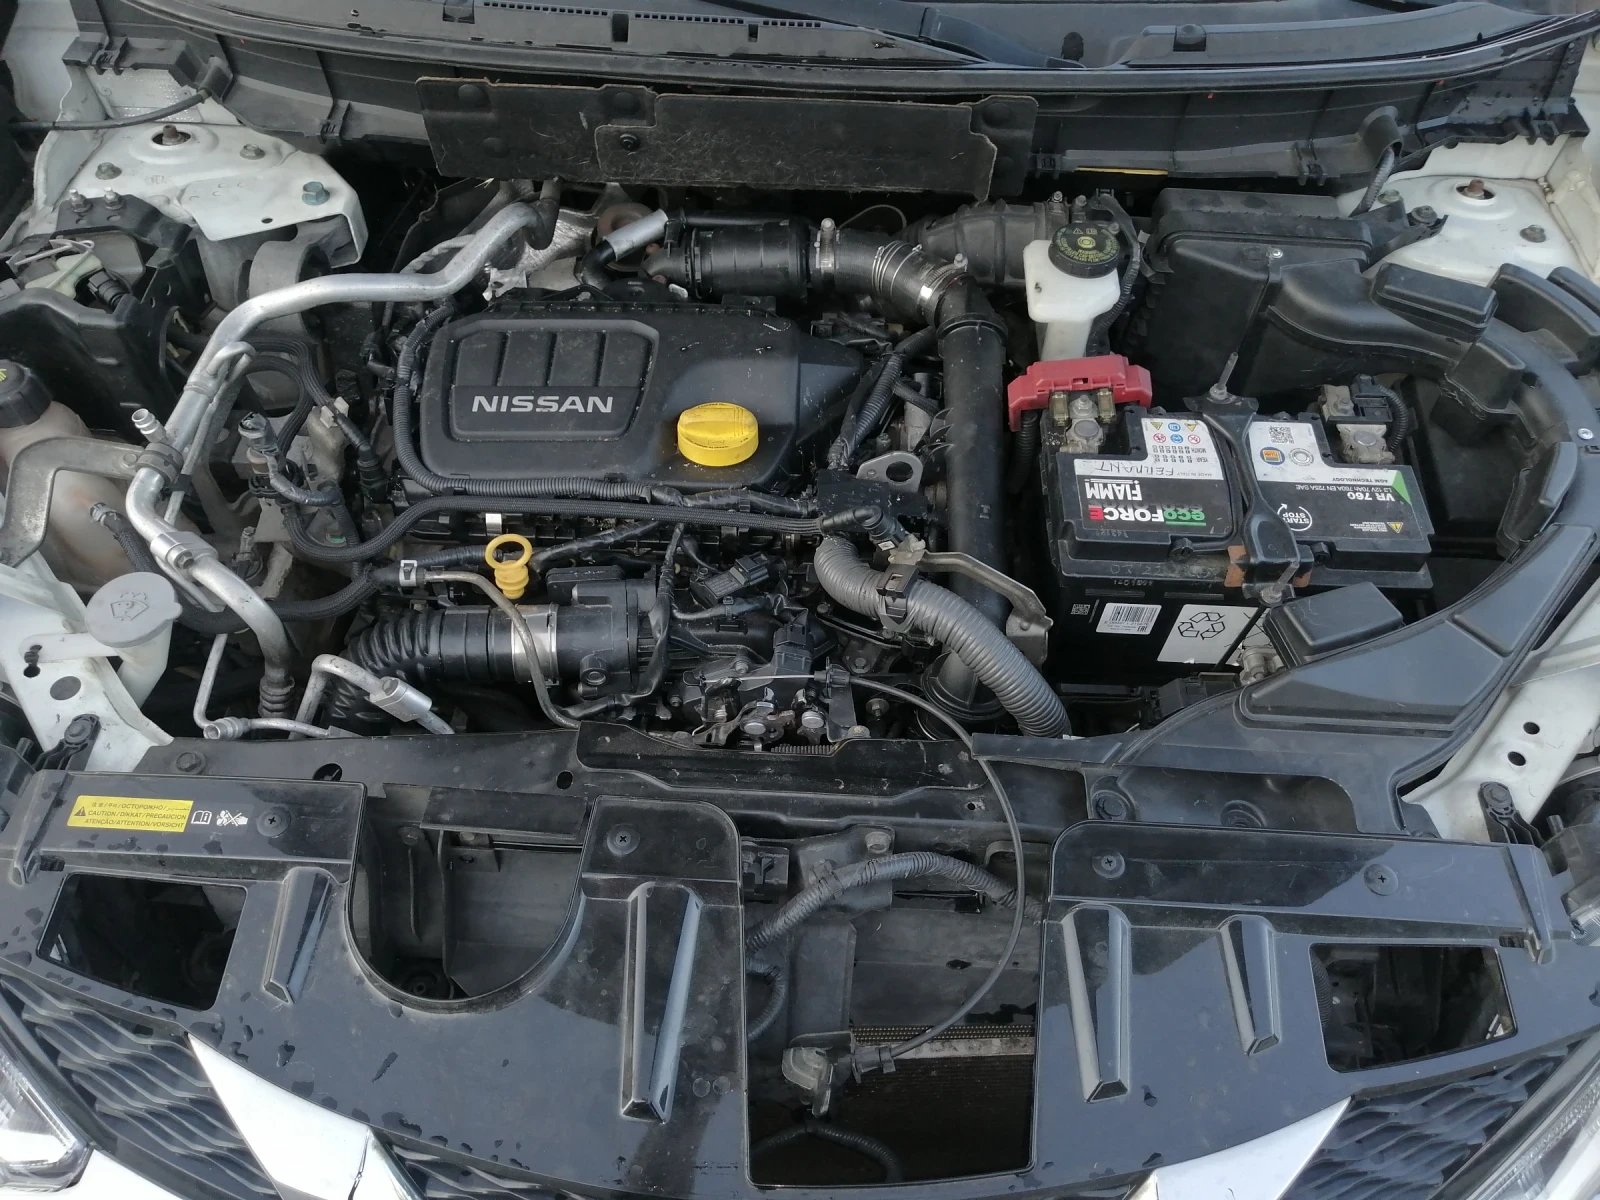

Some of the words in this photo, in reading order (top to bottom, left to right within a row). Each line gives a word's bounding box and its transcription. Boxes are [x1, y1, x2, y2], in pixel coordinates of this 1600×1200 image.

[472, 395, 613, 412] NISSAN
[1085, 483, 1143, 500] FIAMM
[1347, 491, 1373, 501] 760
[1375, 492, 1395, 501] VR
